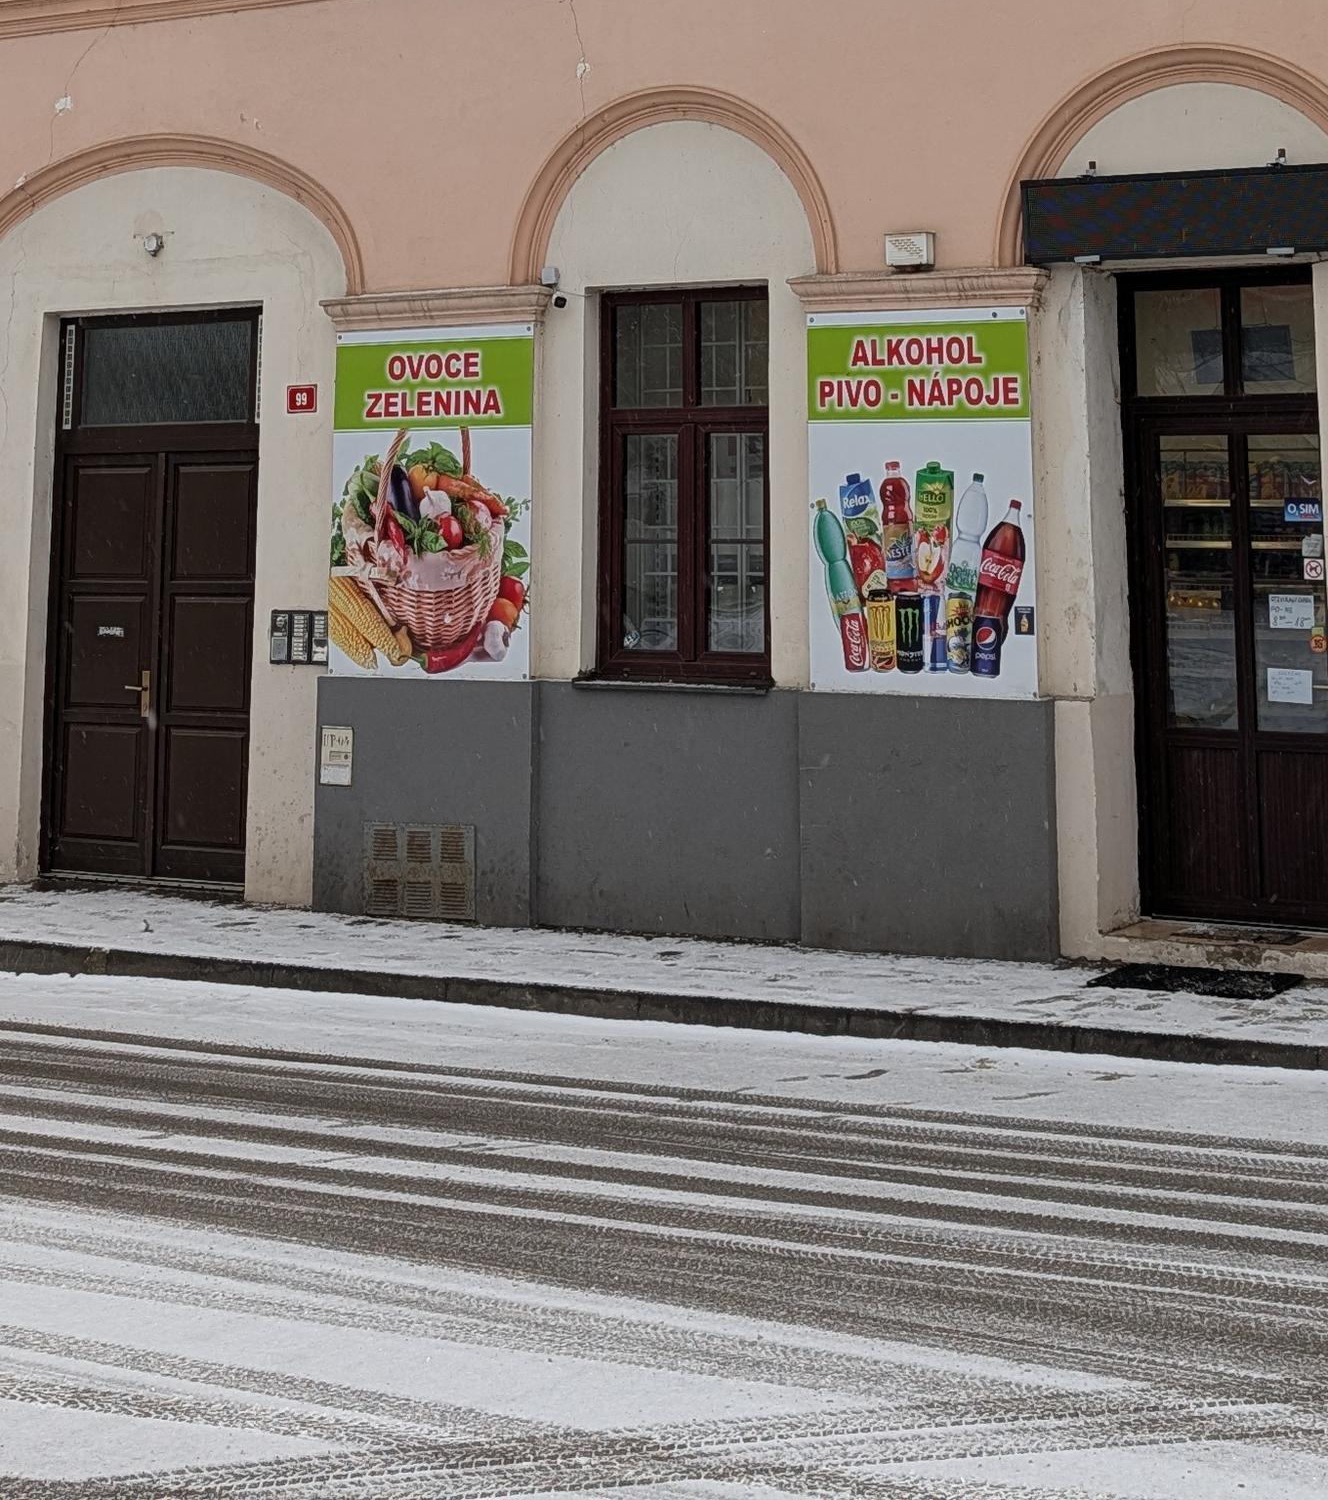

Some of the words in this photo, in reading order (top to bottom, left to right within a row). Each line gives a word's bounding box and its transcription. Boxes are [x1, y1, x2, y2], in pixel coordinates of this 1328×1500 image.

[851, 336, 983, 367] ALKOHOL
[388, 352, 480, 381] OVOCE
[295, 392, 308, 407] 99
[818, 379, 882, 409] PIVO
[906, 371, 1020, 406] NÁPOJE
[364, 390, 502, 418] ZELENINA
[843, 494, 871, 509] Relax
[1299, 503, 1319, 514] SIM
[975, 651, 997, 661] pepsi
